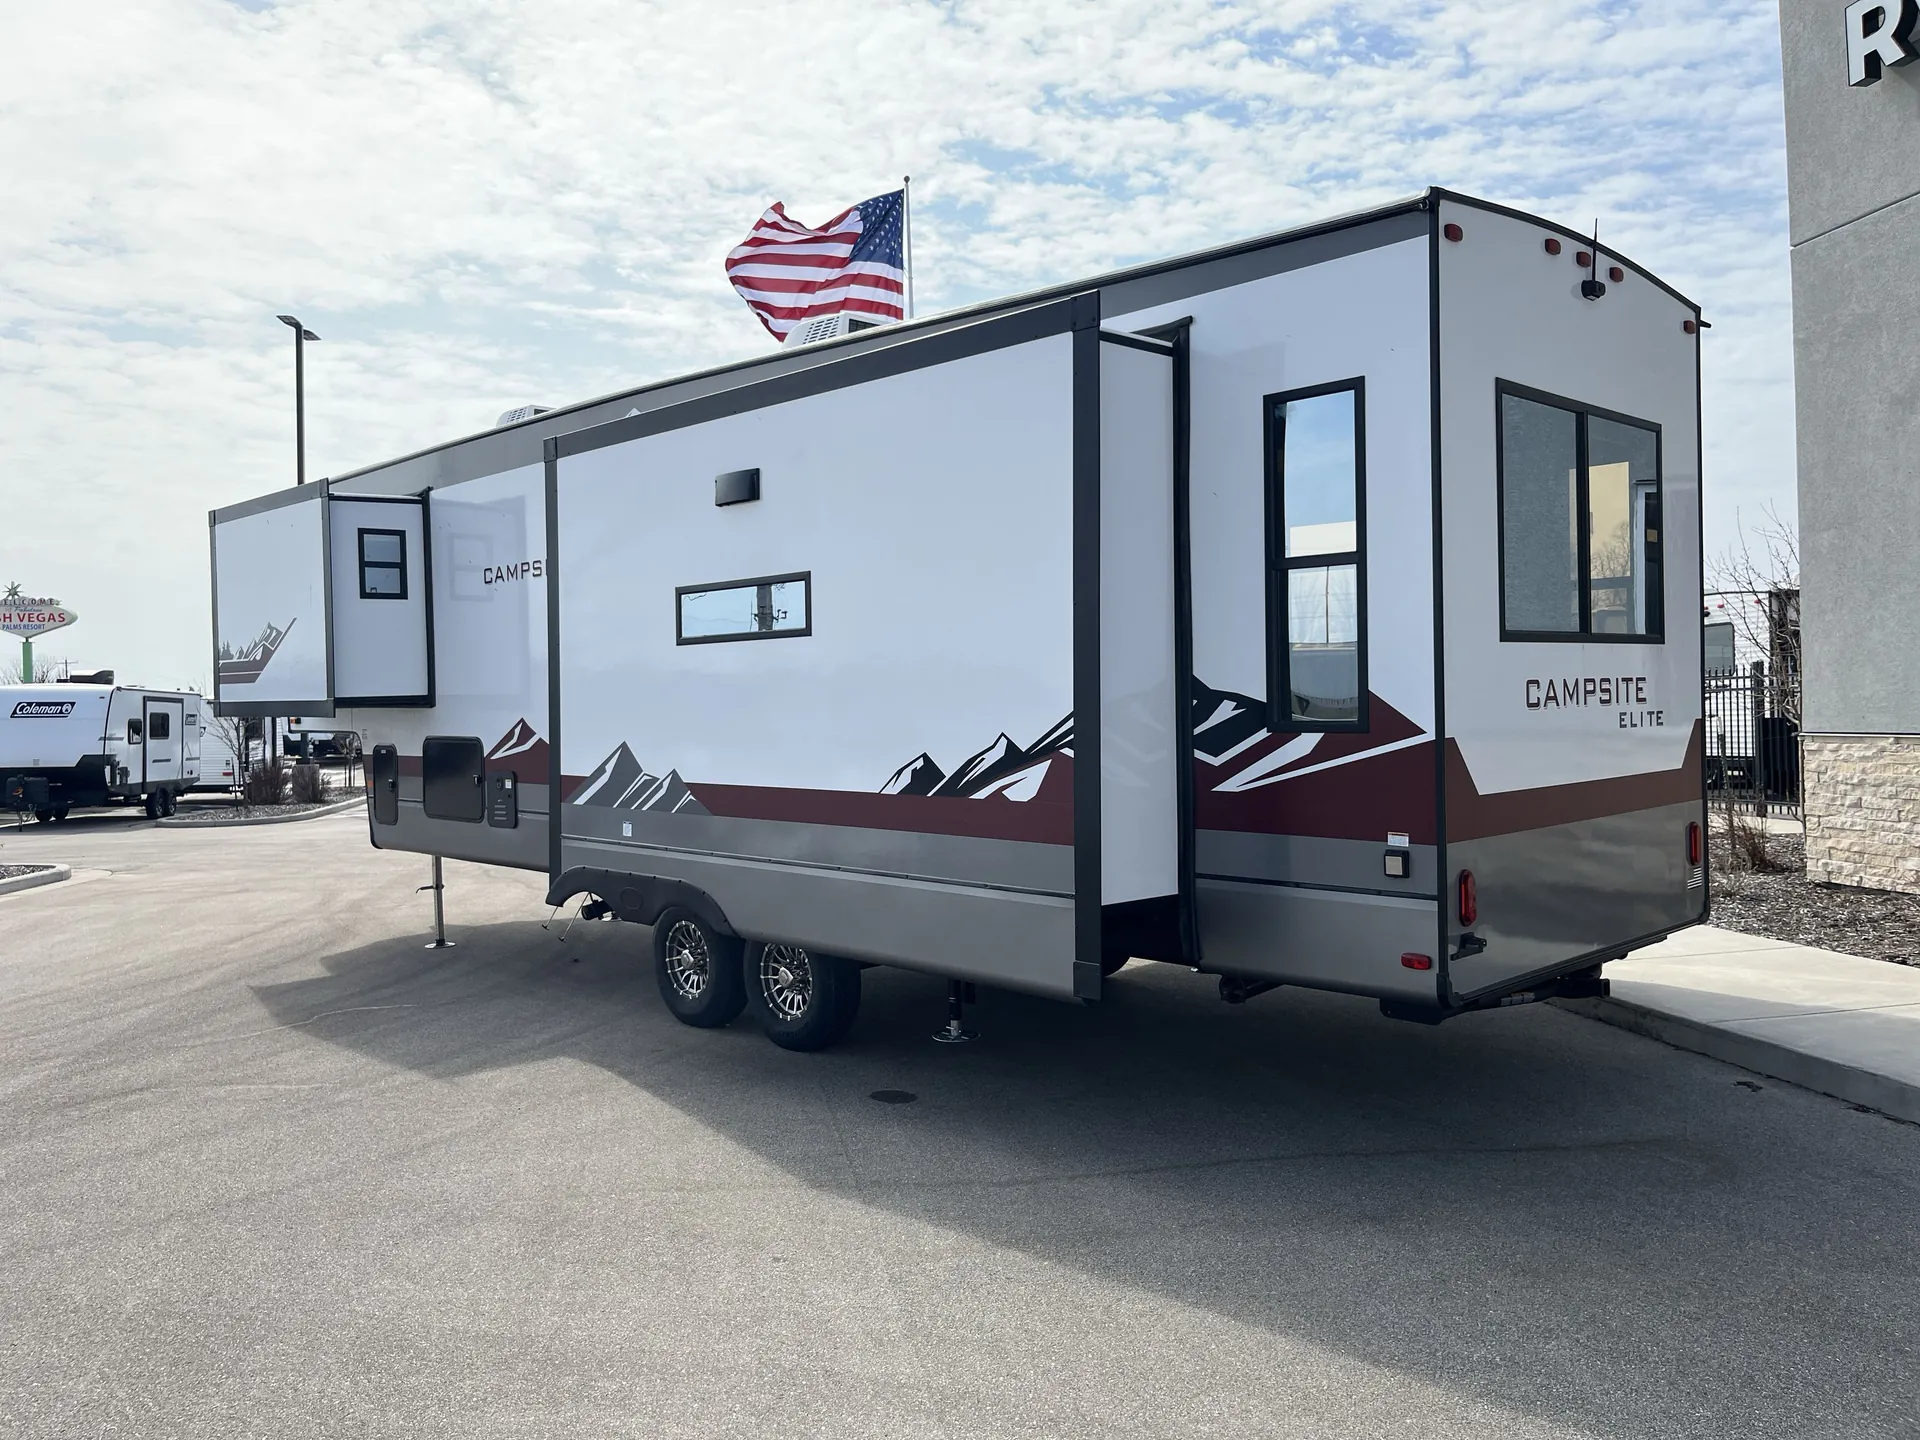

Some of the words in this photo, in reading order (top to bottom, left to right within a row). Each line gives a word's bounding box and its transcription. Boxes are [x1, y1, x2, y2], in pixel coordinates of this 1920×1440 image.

[1845, 0, 1920, 87] R
[483, 559, 548, 585] CAMPS
[0, 598, 55, 606] ELCOME
[0, 612, 13, 623] H
[17, 612, 66, 623] VEGAS
[22, 623, 46, 631] RESORT
[1525, 676, 1648, 710] CAMPSITE
[16, 702, 62, 715] Coleman
[1619, 710, 1664, 729] ELITE
